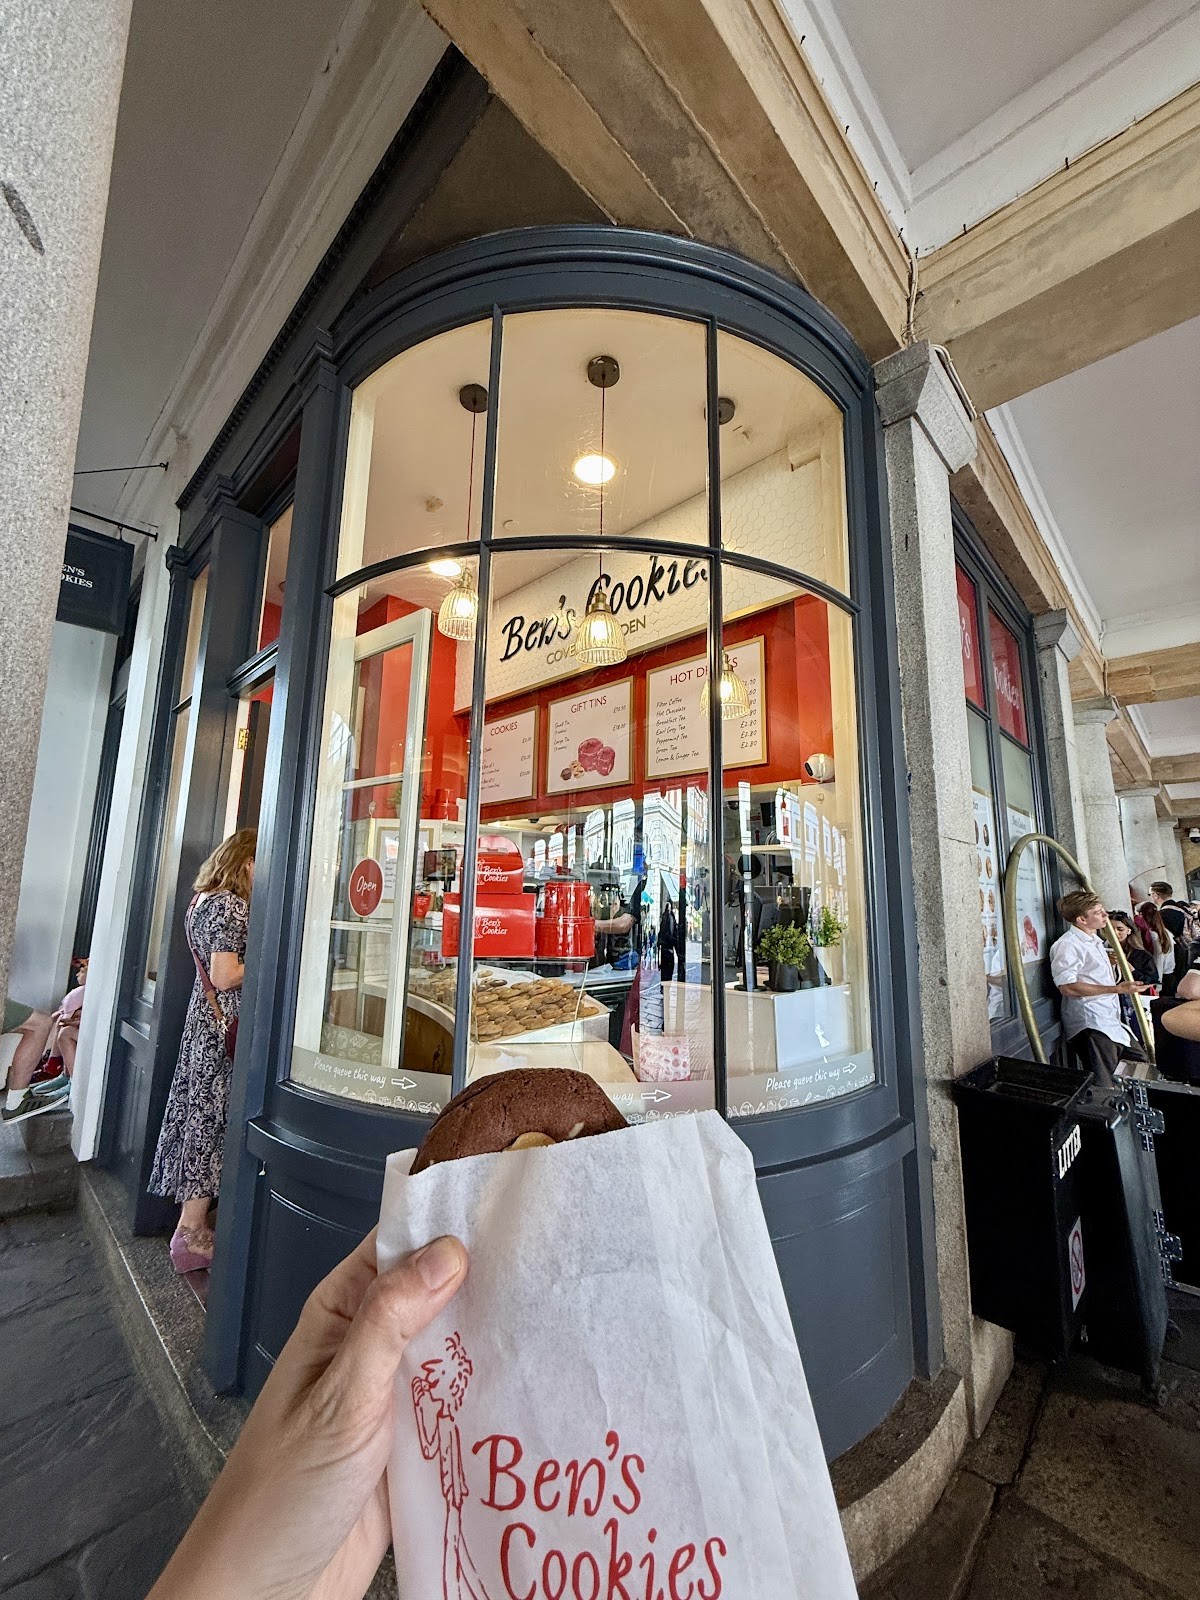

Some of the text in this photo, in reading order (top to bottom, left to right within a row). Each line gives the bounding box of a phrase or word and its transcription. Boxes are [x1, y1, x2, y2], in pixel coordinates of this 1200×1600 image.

[61, 563, 85, 577] EN'S
[60, 572, 93, 589] OKIES
[500, 594, 575, 662] Ben's
[546, 615, 646, 665] COVE DEN
[670, 669, 693, 685] HOT
[571, 695, 607, 713] GIFT TINS
[490, 721, 518, 736] COOKIES
[656, 717, 677, 727] Breakfast
[483, 865, 502, 873] Ben's
[356, 875, 377, 896] Open
[483, 873, 509, 882] Cookies
[481, 917, 502, 927] Ben's
[481, 926, 508, 935] Cookies
[313, 1057, 332, 1073] Please
[353, 1067, 369, 1082] this
[370, 1074, 387, 1089] way
[765, 1077, 791, 1092] Please
[814, 1068, 828, 1082] this
[828, 1068, 841, 1081] way
[612, 1092, 634, 1107] way
[472, 1430, 645, 1517] Ben's
[500, 1518, 727, 1600] Cookies
